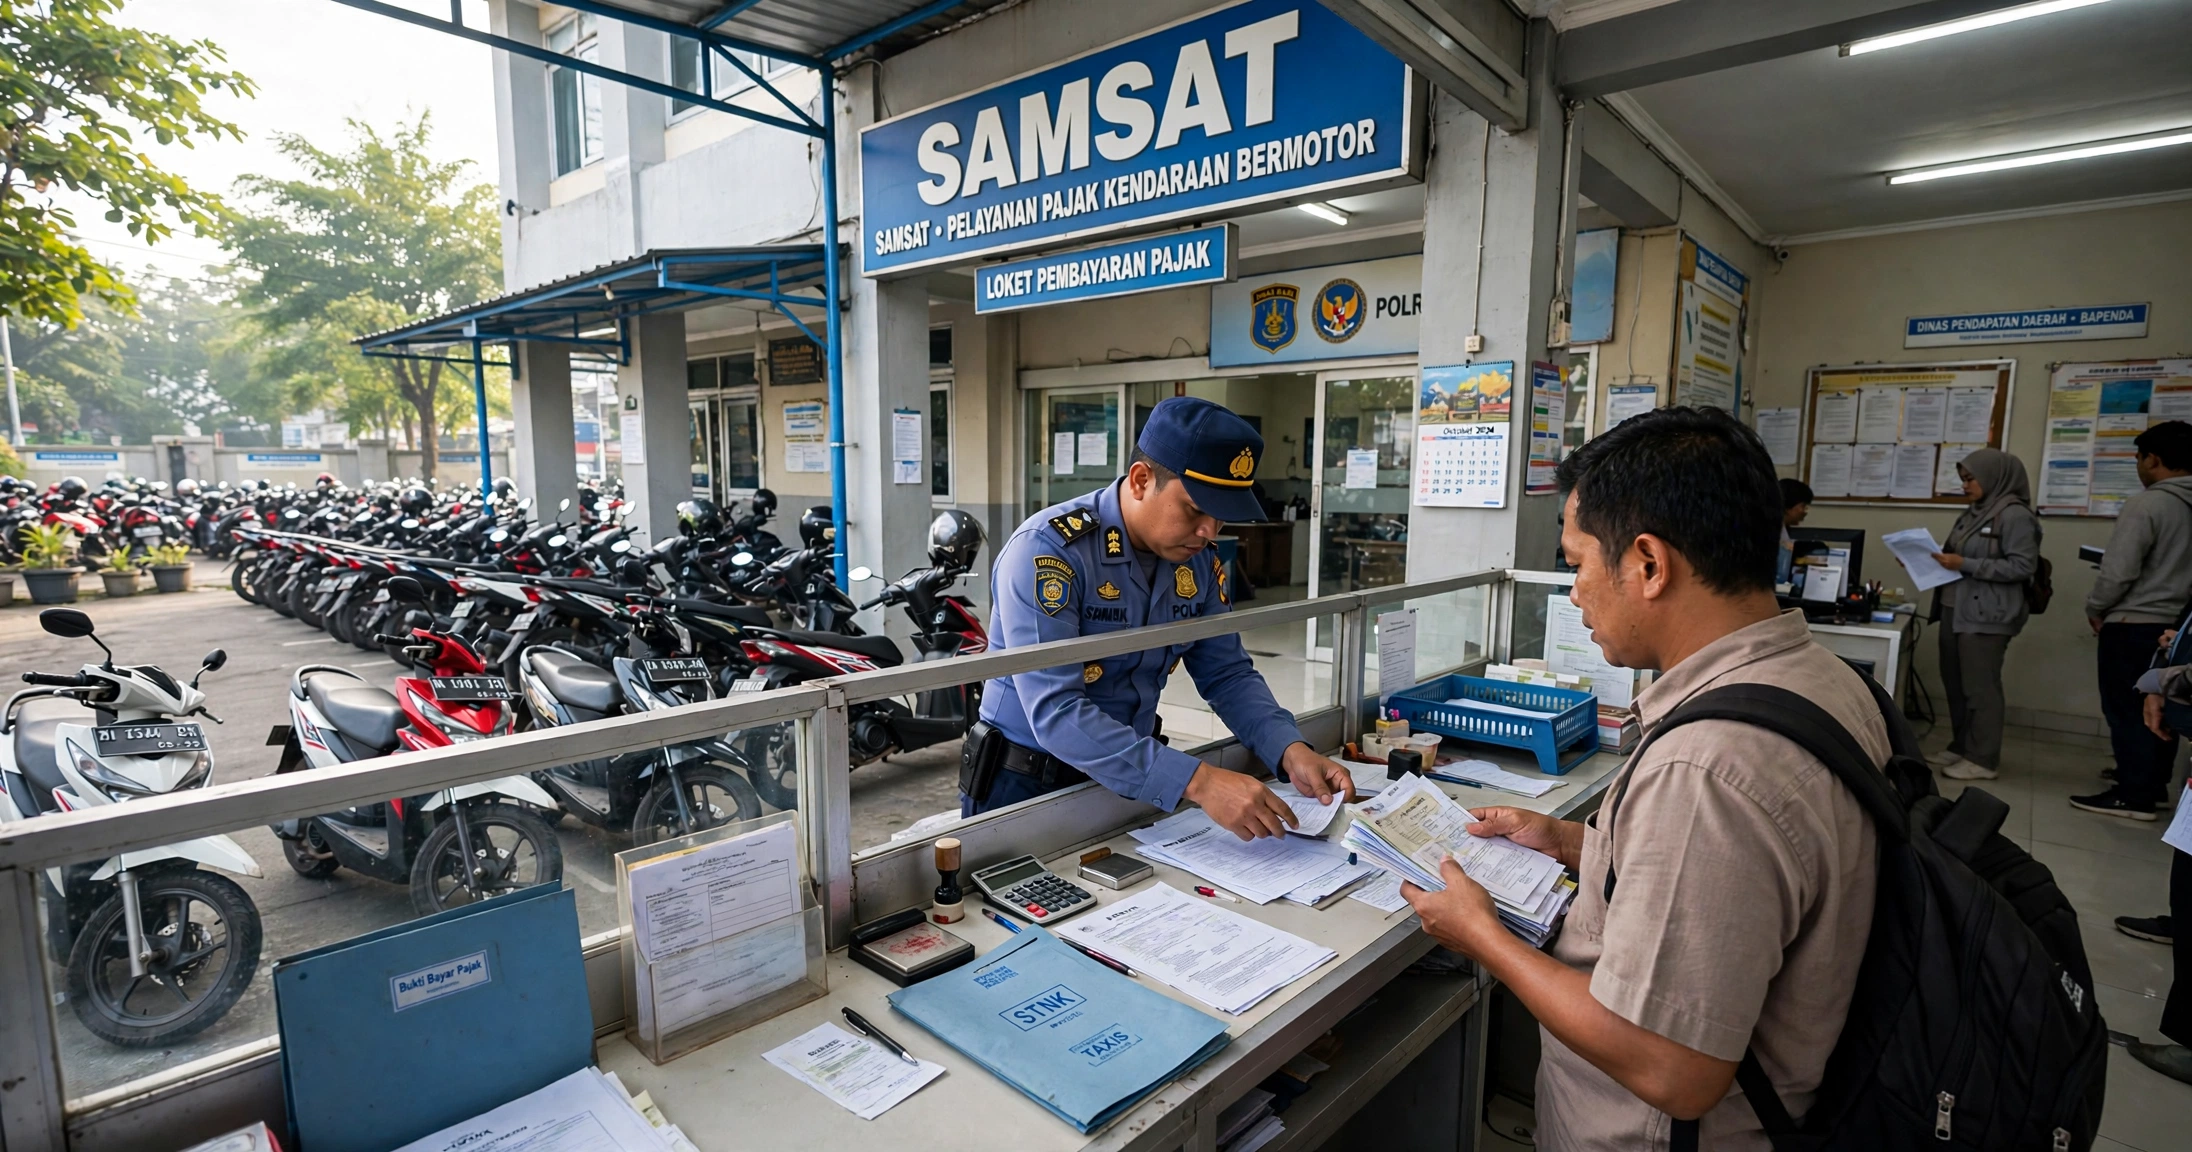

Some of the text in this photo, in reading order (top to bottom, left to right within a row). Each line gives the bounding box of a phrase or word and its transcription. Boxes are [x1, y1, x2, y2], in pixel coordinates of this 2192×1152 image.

[916, 10, 1299, 206] SAMSAT
[875, 118, 1375, 256] SAMSAT PELAYANAN PAJAK KENDARAAN BERMOTOR
[986, 240, 1211, 300] LOKET PEMBAYARAN PAJAK
[1917, 309, 2134, 333] DINAS PENDAPATAN DAERAH BAPENDA
[399, 975, 425, 993] Bukti
[427, 968, 454, 984] Bayar
[457, 959, 482, 975] Pajak
[1013, 991, 1076, 1024] STNK
[1080, 1031, 1129, 1058] TAXIS
